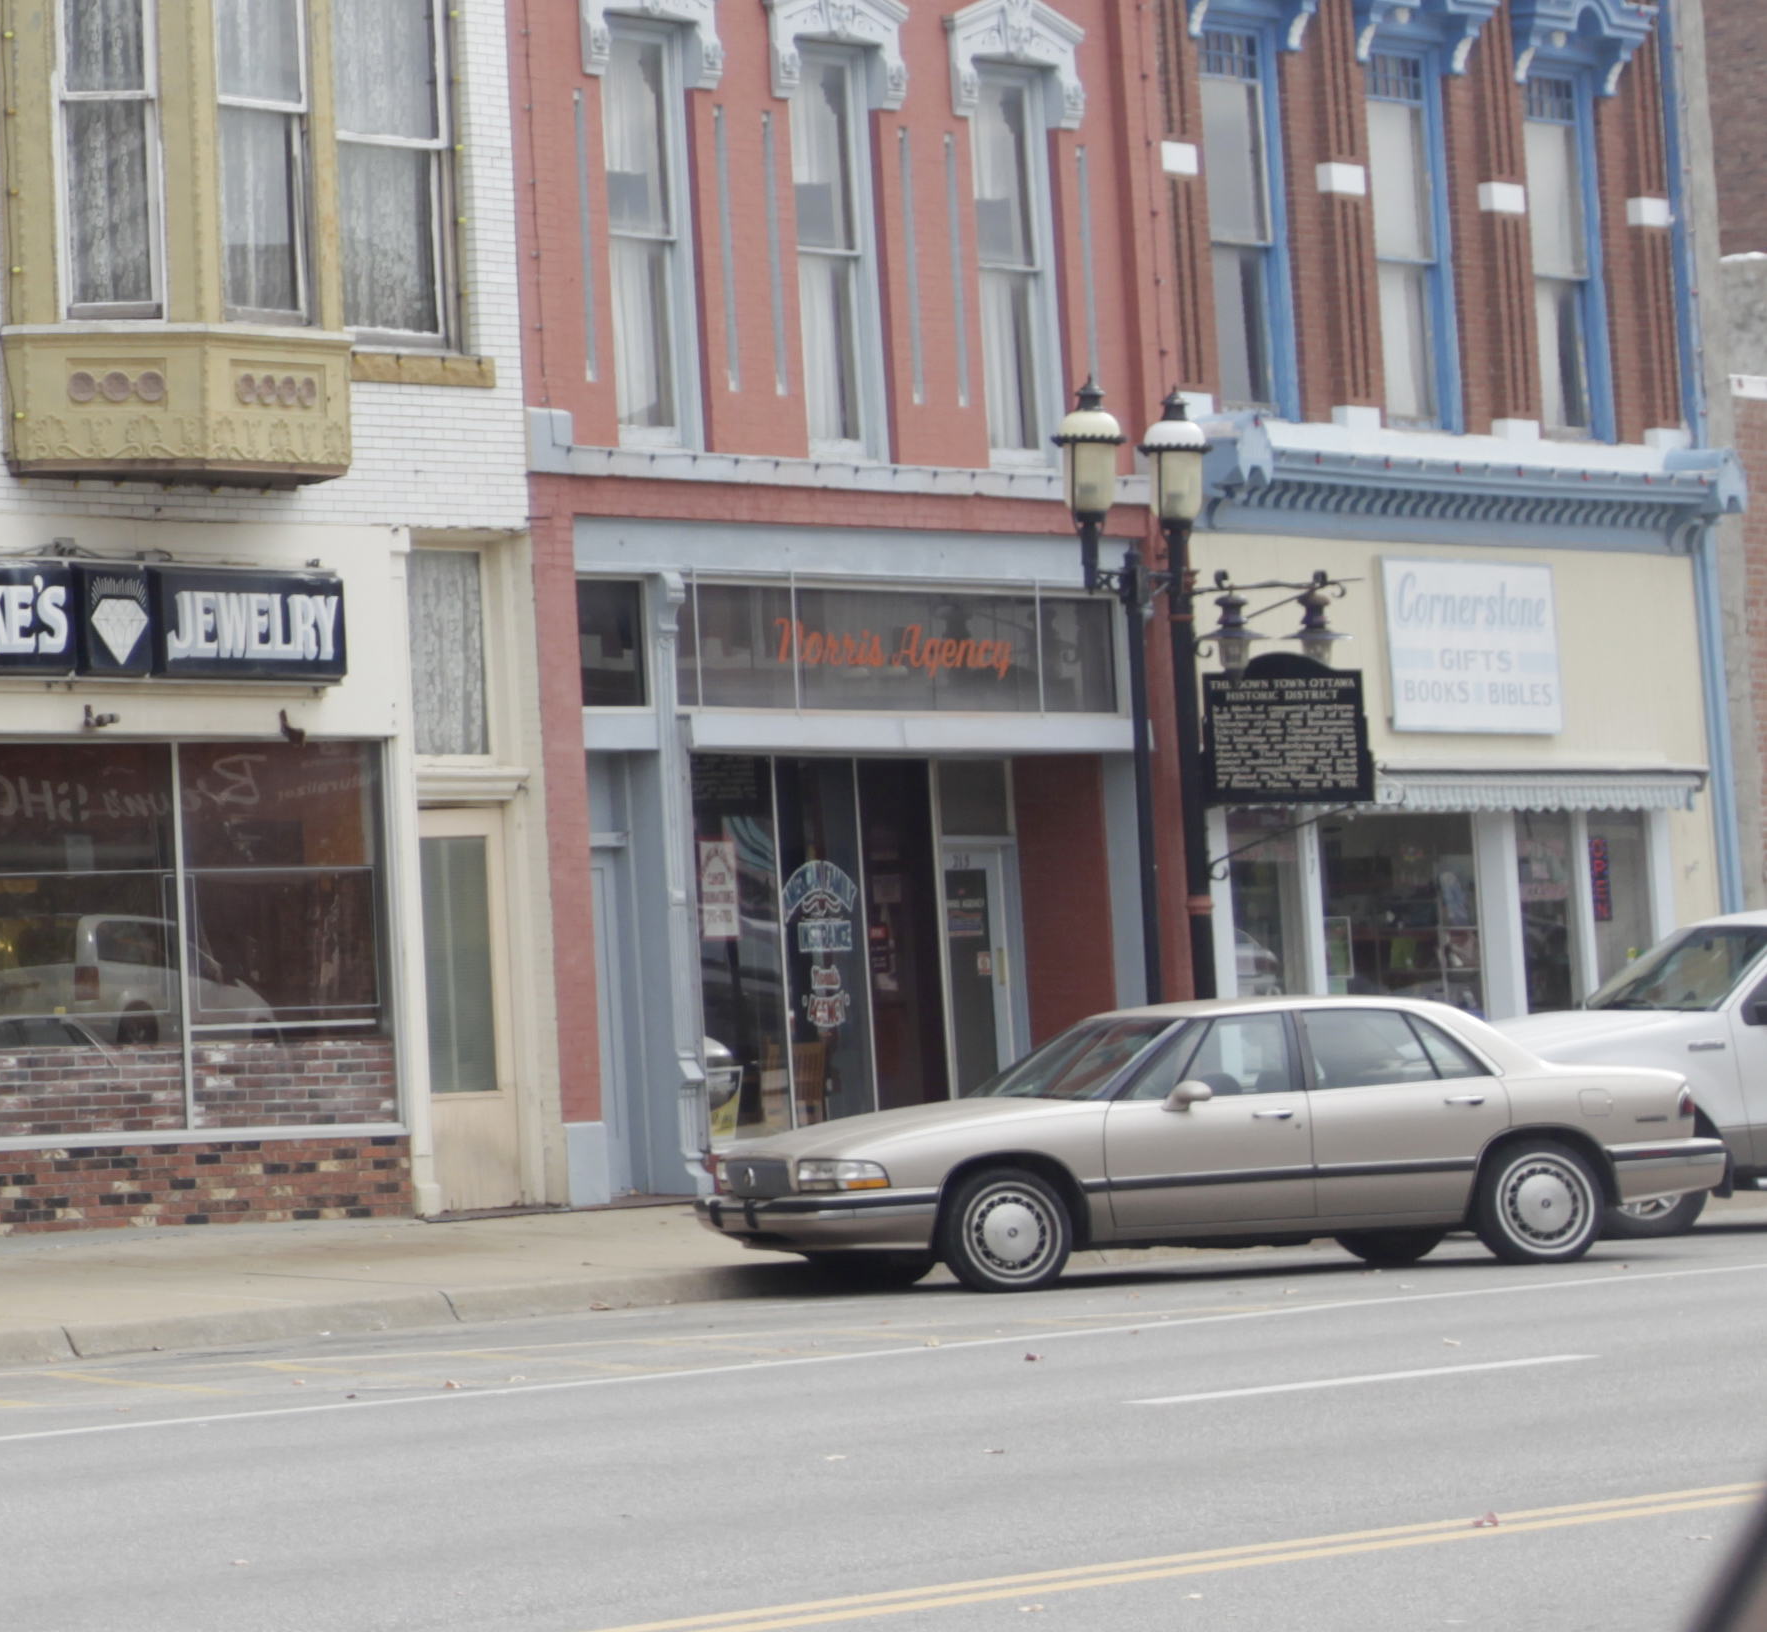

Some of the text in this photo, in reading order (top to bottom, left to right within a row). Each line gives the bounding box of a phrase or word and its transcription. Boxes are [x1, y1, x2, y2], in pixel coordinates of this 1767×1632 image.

[1394, 570, 1546, 628] Cornerstone
[167, 590, 341, 662] JEWELRY
[774, 617, 1014, 680] Norris Agency
[1439, 647, 1513, 673] GIFTS
[1225, 689, 1339, 701] HISTORIC DISTRICT
[1273, 678, 1306, 689] TOWN
[1309, 677, 1356, 689] OTTAWA
[1403, 679, 1553, 707] BOOKS BIBLES
